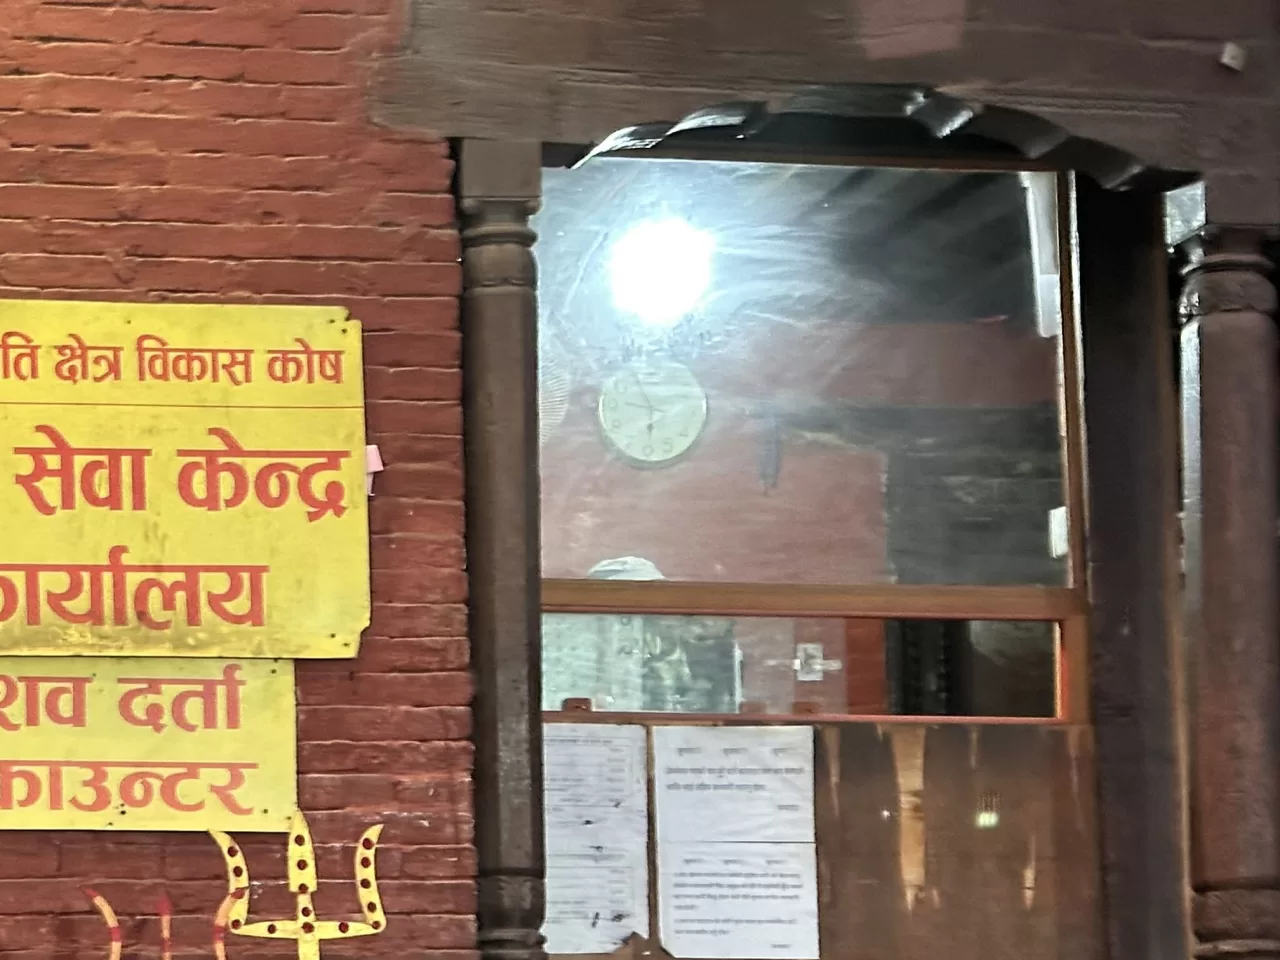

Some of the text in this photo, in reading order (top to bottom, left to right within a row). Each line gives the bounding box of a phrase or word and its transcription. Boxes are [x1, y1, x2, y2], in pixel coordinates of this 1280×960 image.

[54, 334, 124, 383] क्षेत्र
[137, 334, 255, 387] विकास
[267, 339, 345, 385] कोष
[14, 424, 153, 516] सेवा
[177, 428, 351, 523] केन्द्र
[118, 664, 247, 734] दर्ता
